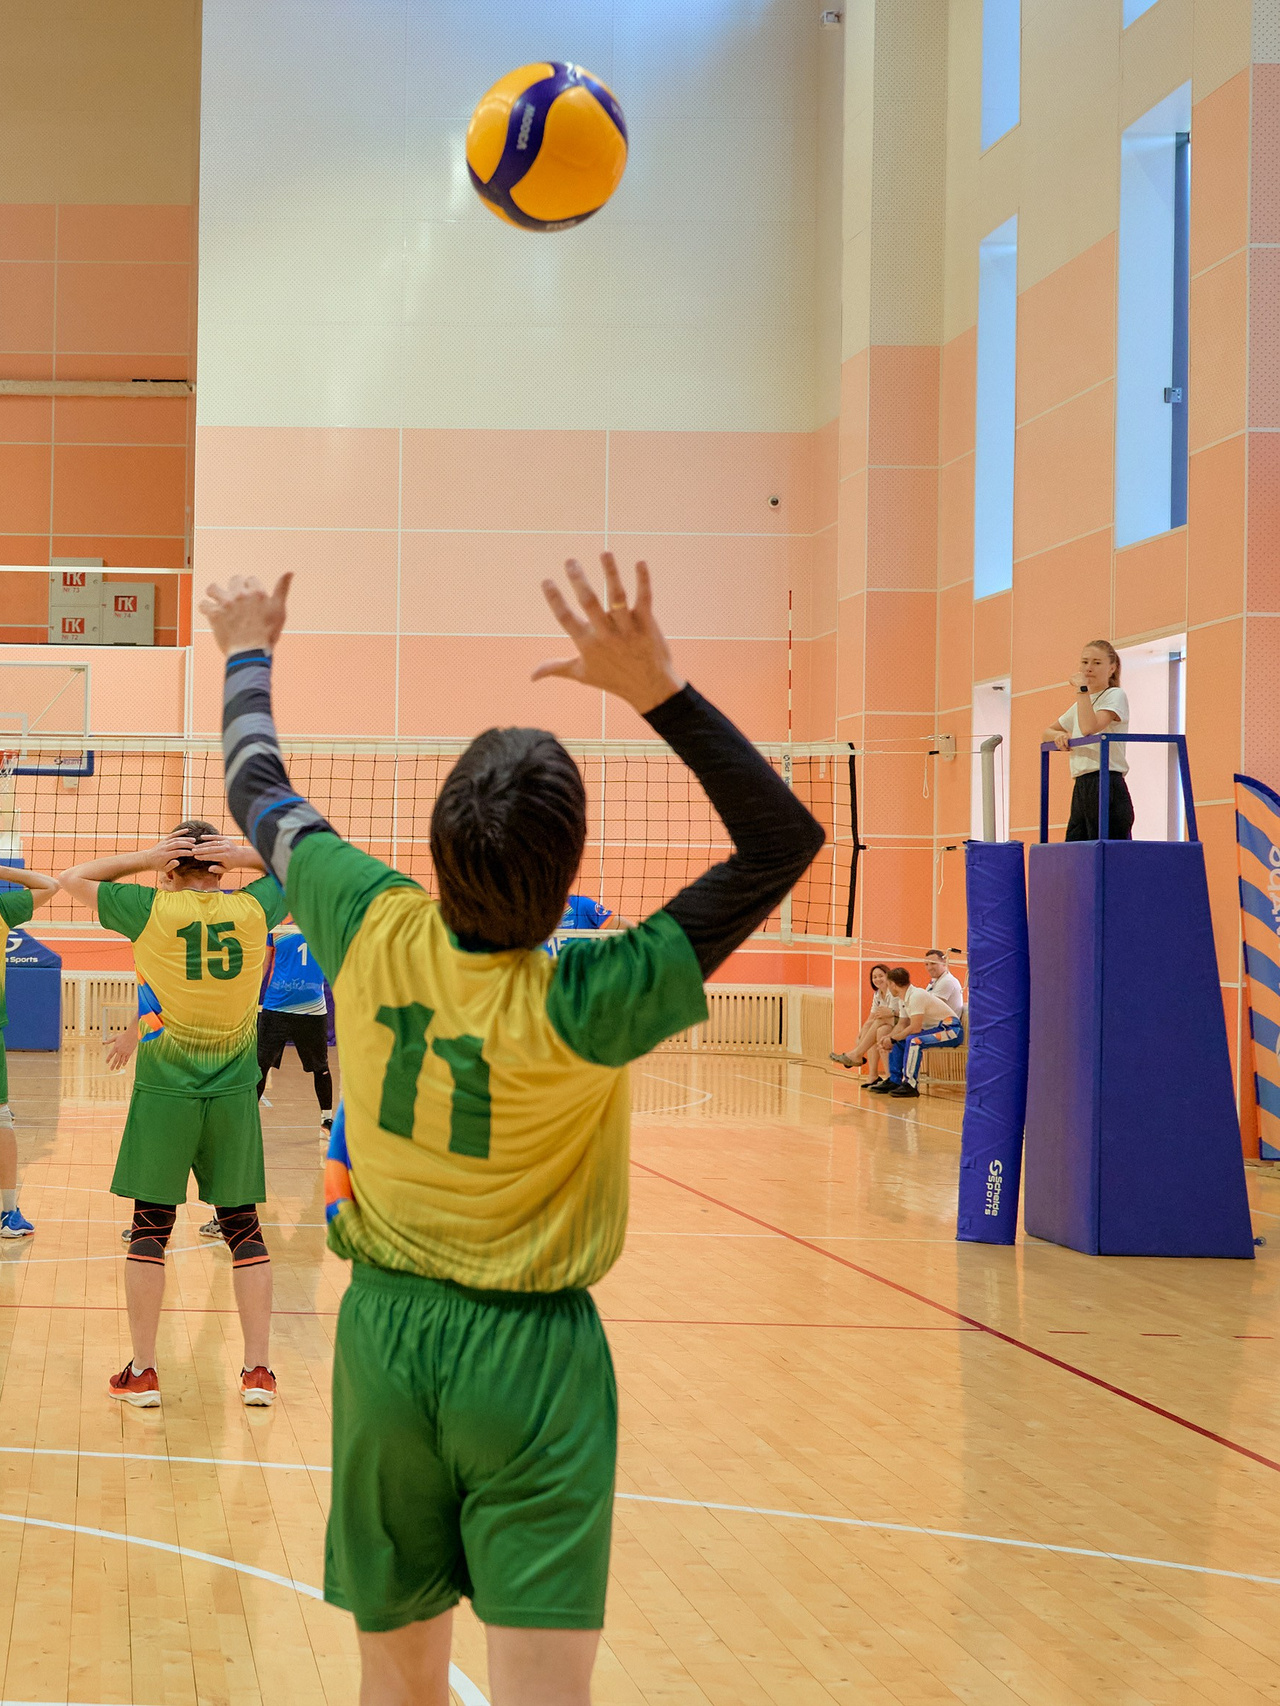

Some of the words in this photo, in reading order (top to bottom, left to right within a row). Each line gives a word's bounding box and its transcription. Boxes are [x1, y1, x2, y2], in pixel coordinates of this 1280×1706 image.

[10, 956, 39, 964] Sports
[176, 921, 244, 981] 15
[373, 1000, 492, 1160] 11
[984, 1174, 996, 1216] Sports
